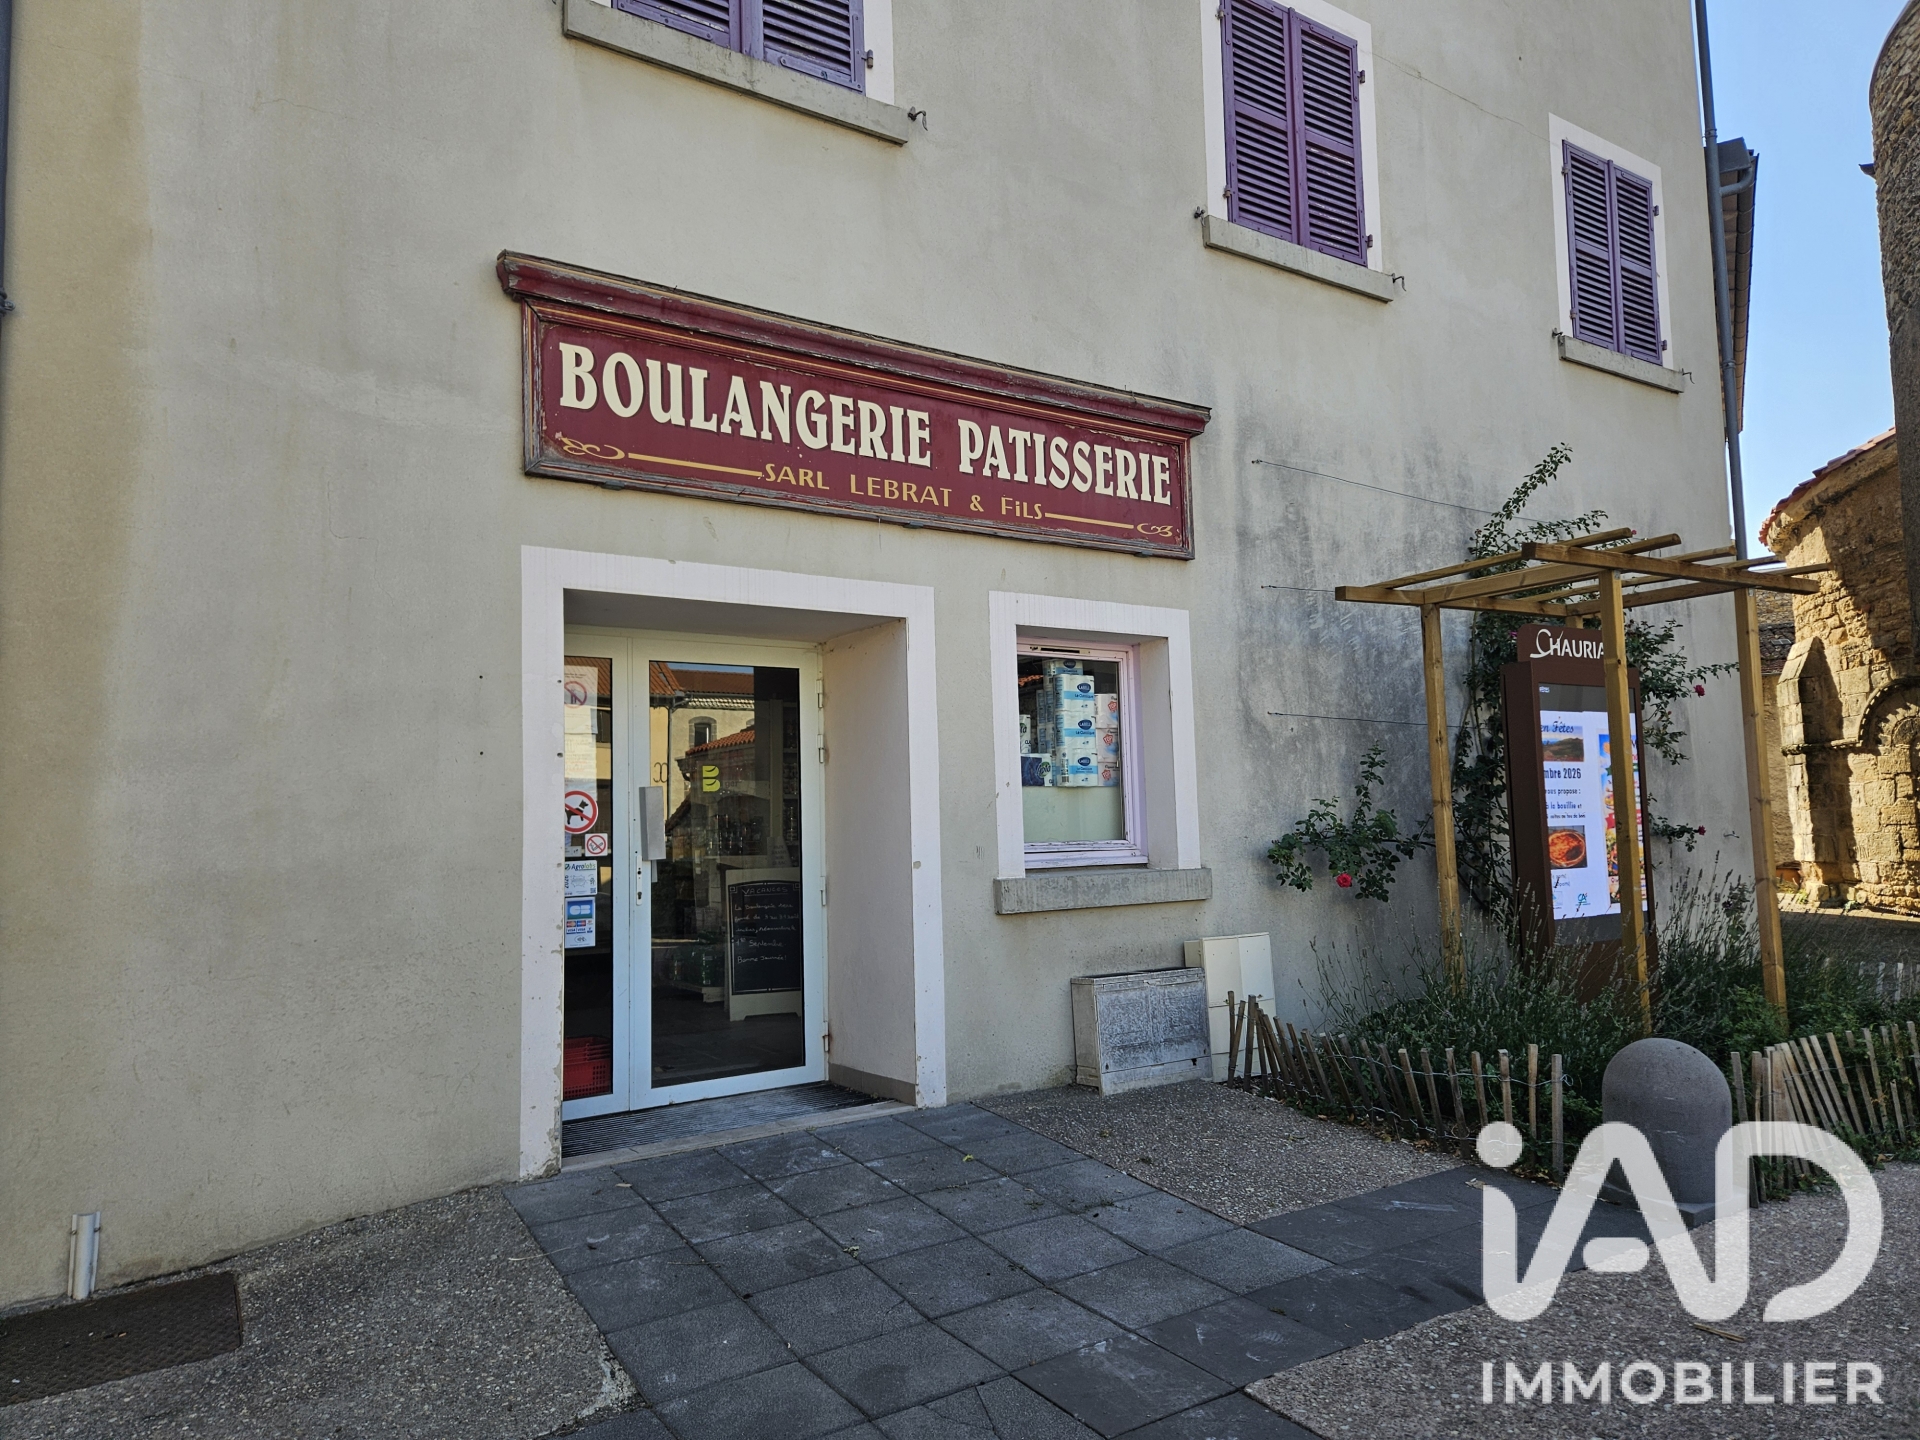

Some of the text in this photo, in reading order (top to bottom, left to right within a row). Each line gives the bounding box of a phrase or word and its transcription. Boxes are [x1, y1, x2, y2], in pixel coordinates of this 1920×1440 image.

[559, 342, 1173, 505] BOULANGERIE PATISSERIE
[764, 463, 830, 491] SARL
[850, 474, 952, 507] LEBRAT
[969, 494, 984, 512] &
[1552, 721, 1574, 733] Fêtes
[1563, 767, 1582, 779] 2026
